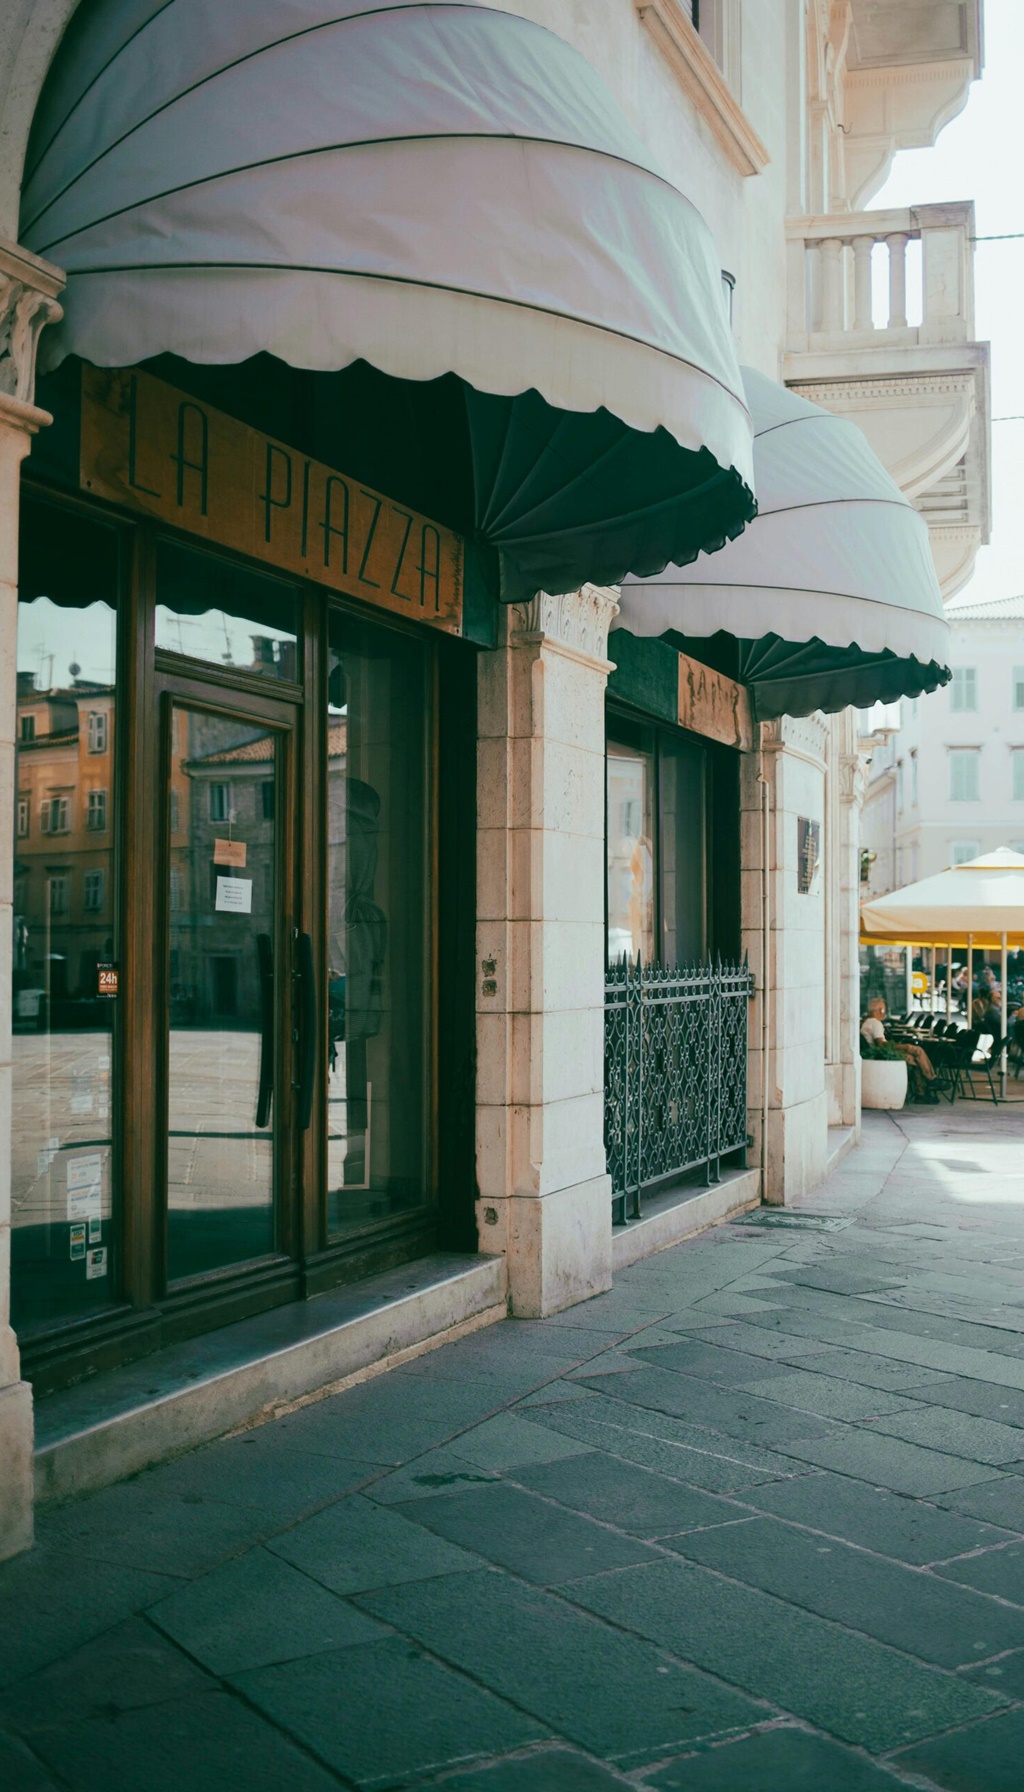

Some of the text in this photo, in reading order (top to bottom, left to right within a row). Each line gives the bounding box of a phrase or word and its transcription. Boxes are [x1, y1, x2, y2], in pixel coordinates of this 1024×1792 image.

[128, 374, 441, 612] LA PIAZZA
[100, 972, 118, 985] 24h
